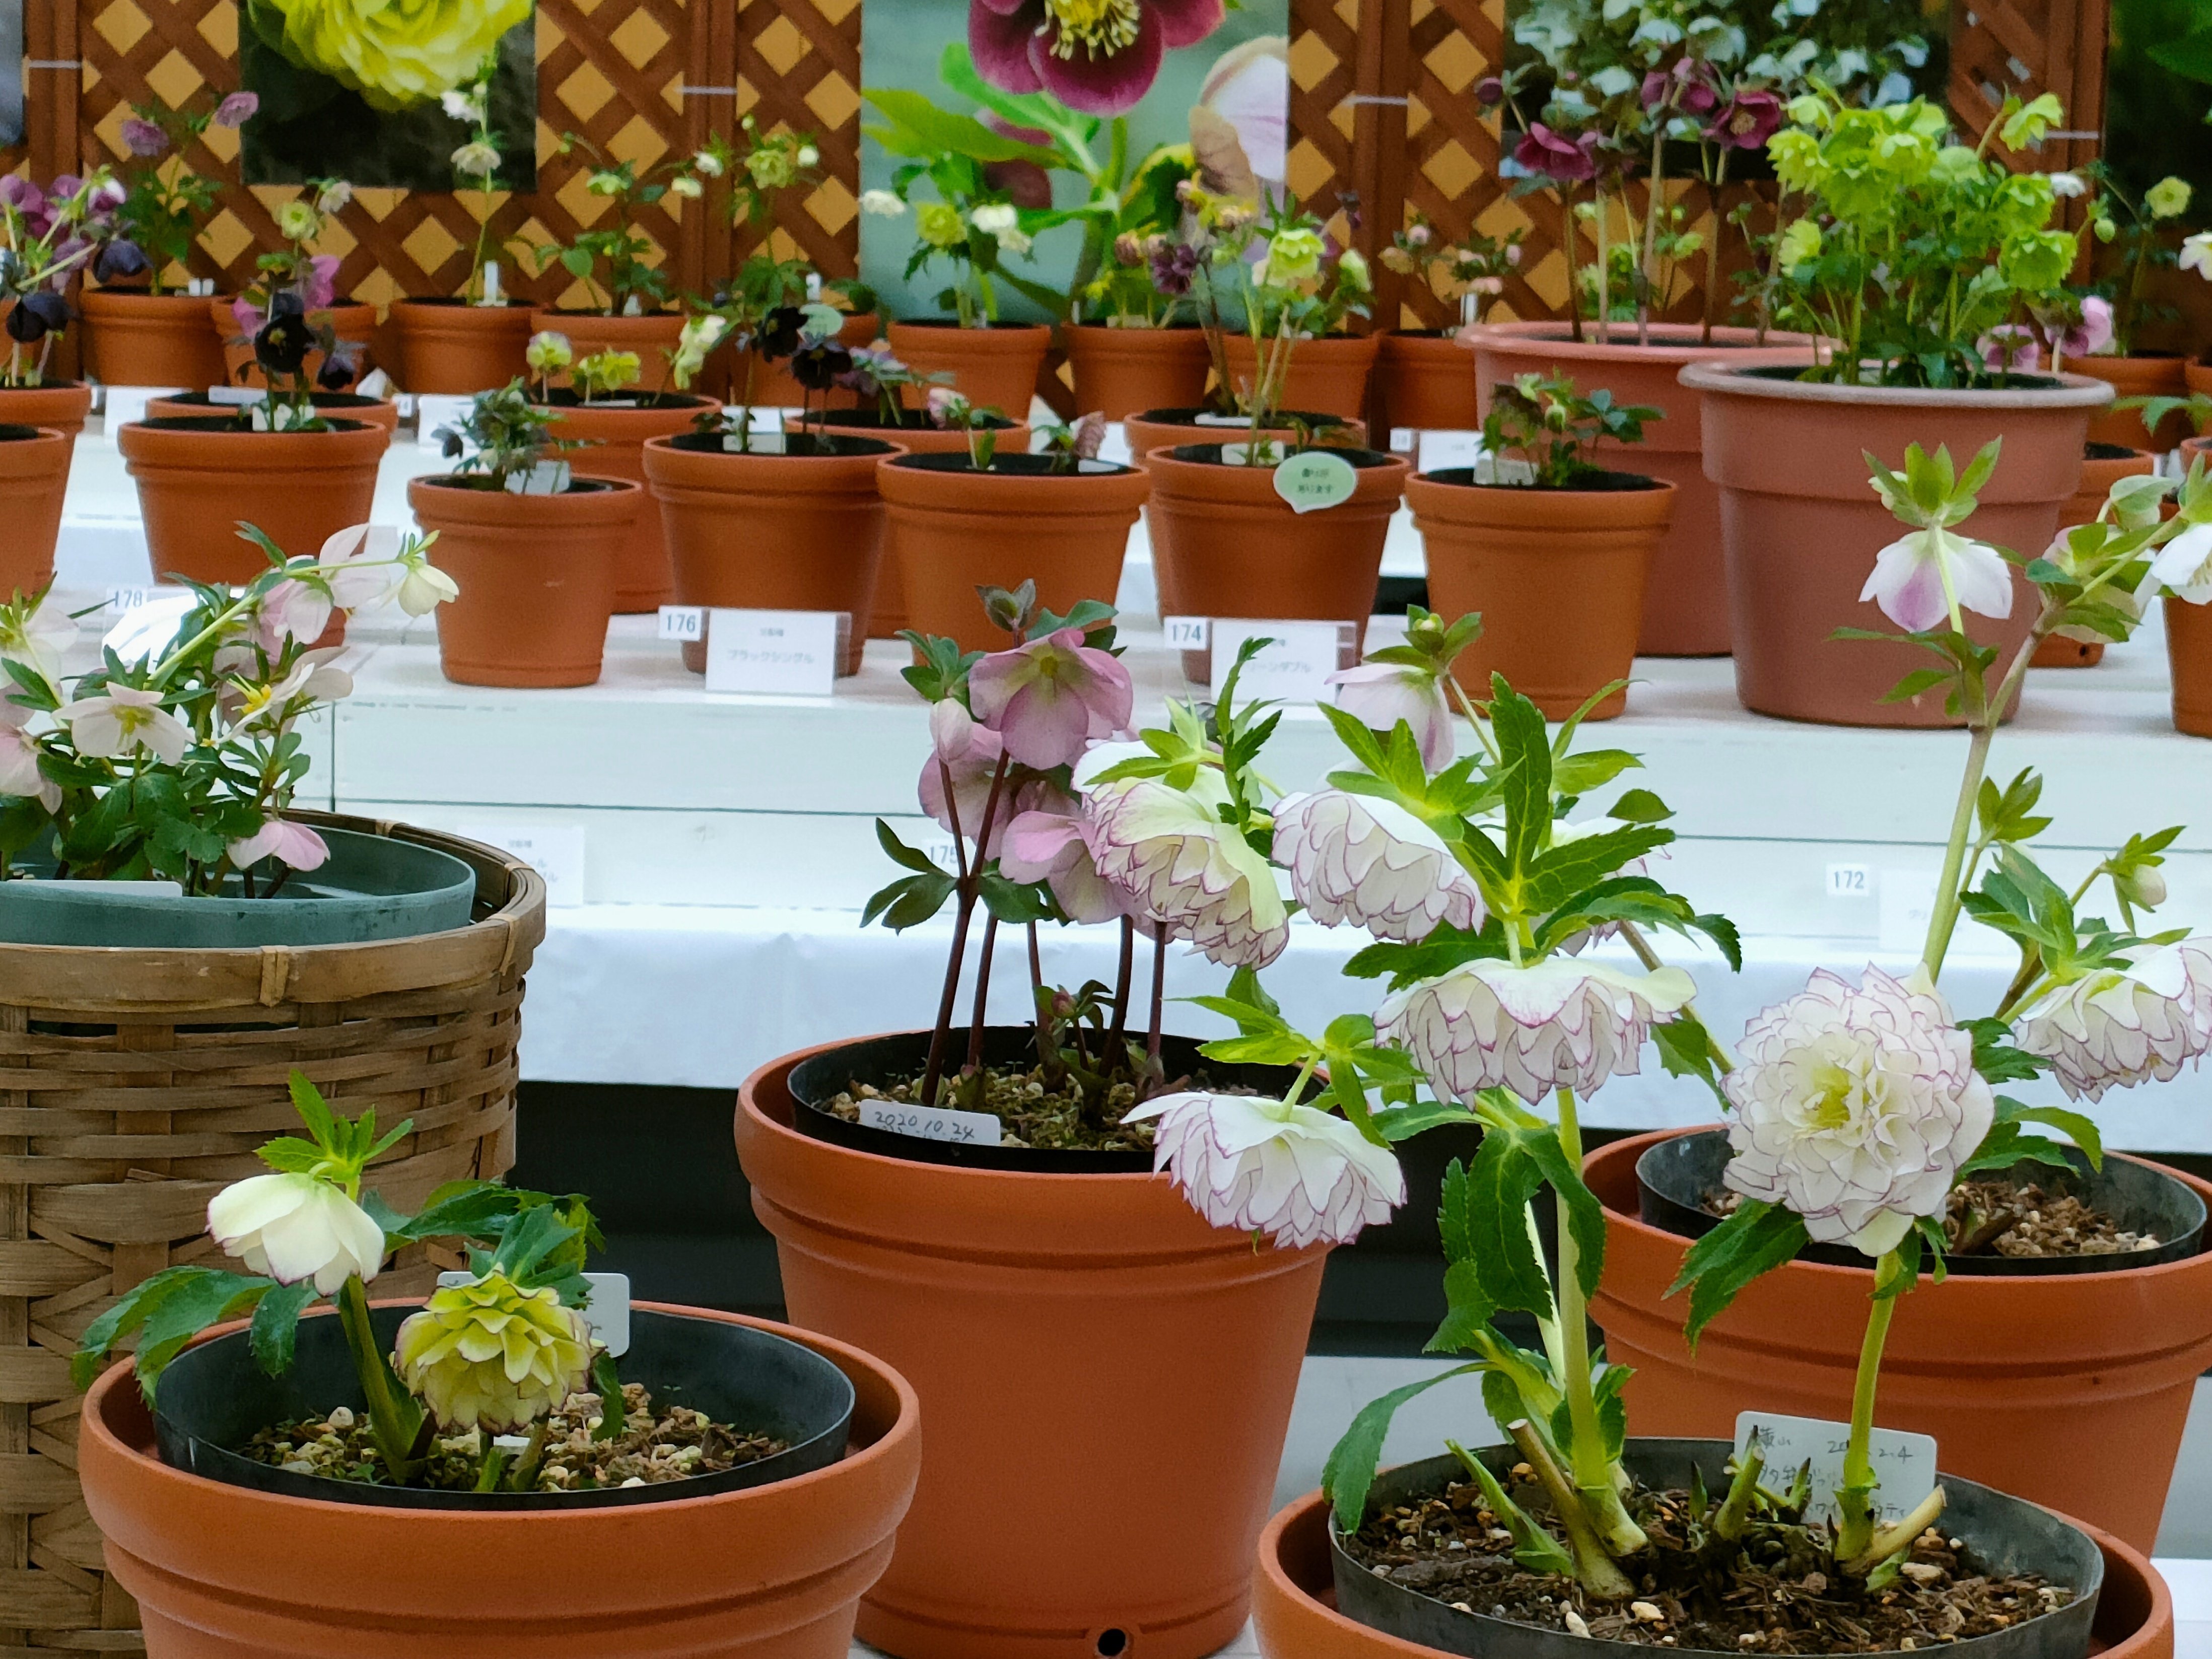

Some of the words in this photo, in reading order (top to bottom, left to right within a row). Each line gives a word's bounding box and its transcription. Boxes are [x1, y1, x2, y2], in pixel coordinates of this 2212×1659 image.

[114, 590, 143, 608] 178
[666, 613, 696, 633] 176
[1171, 624, 1201, 642] 174
[1834, 870, 1864, 890] 172
